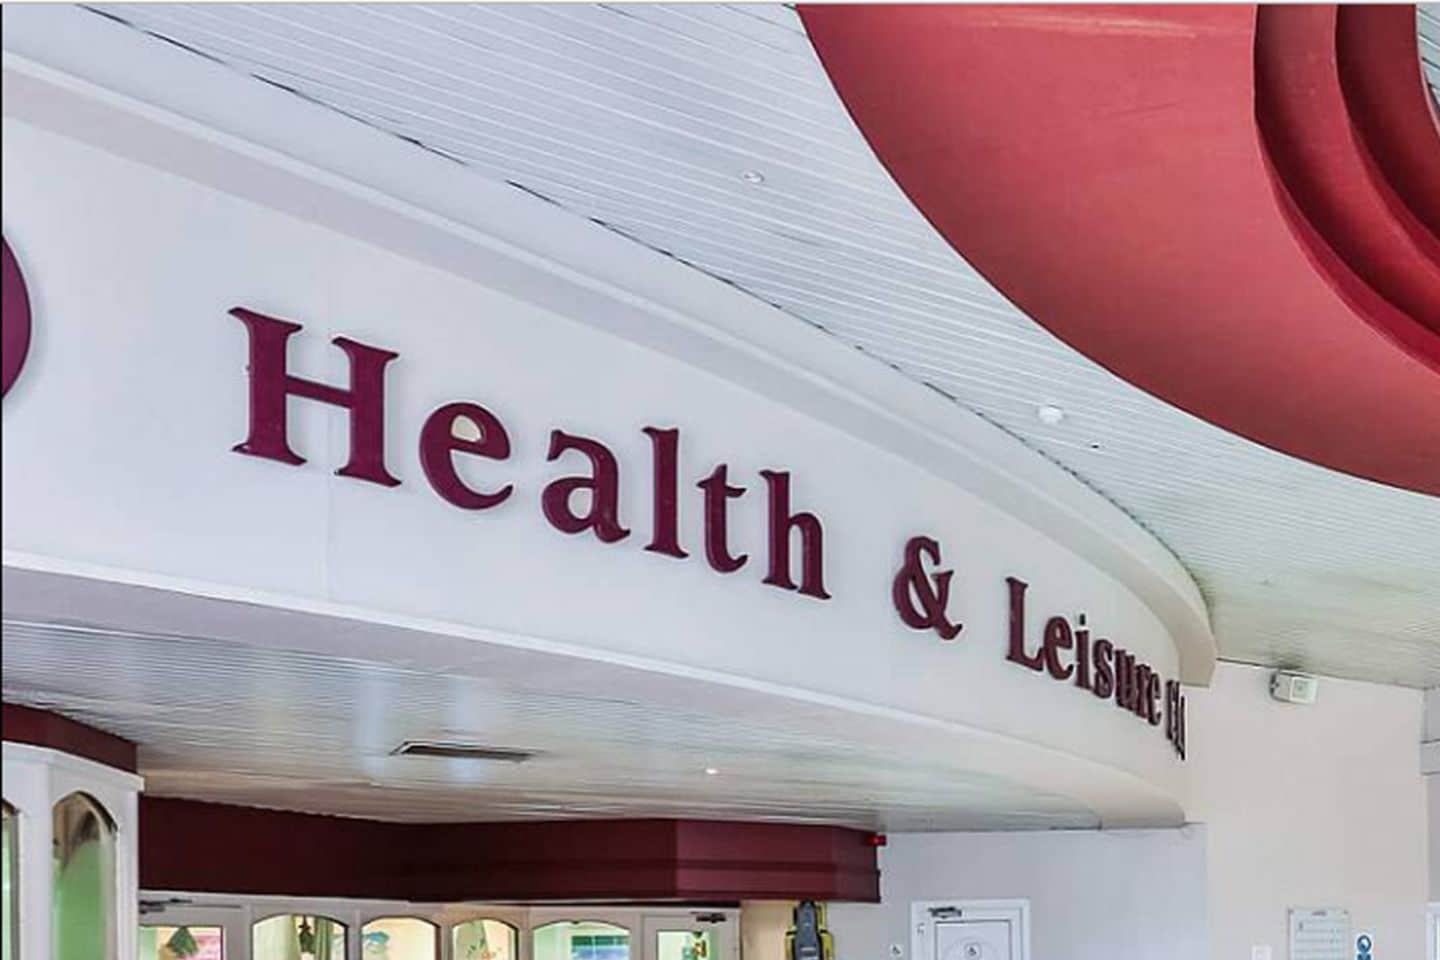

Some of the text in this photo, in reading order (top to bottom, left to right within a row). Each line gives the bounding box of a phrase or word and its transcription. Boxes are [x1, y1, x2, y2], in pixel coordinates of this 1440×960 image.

[228, 306, 831, 601] Health
[892, 536, 962, 640] &
[1005, 577, 1161, 727] Leisure
